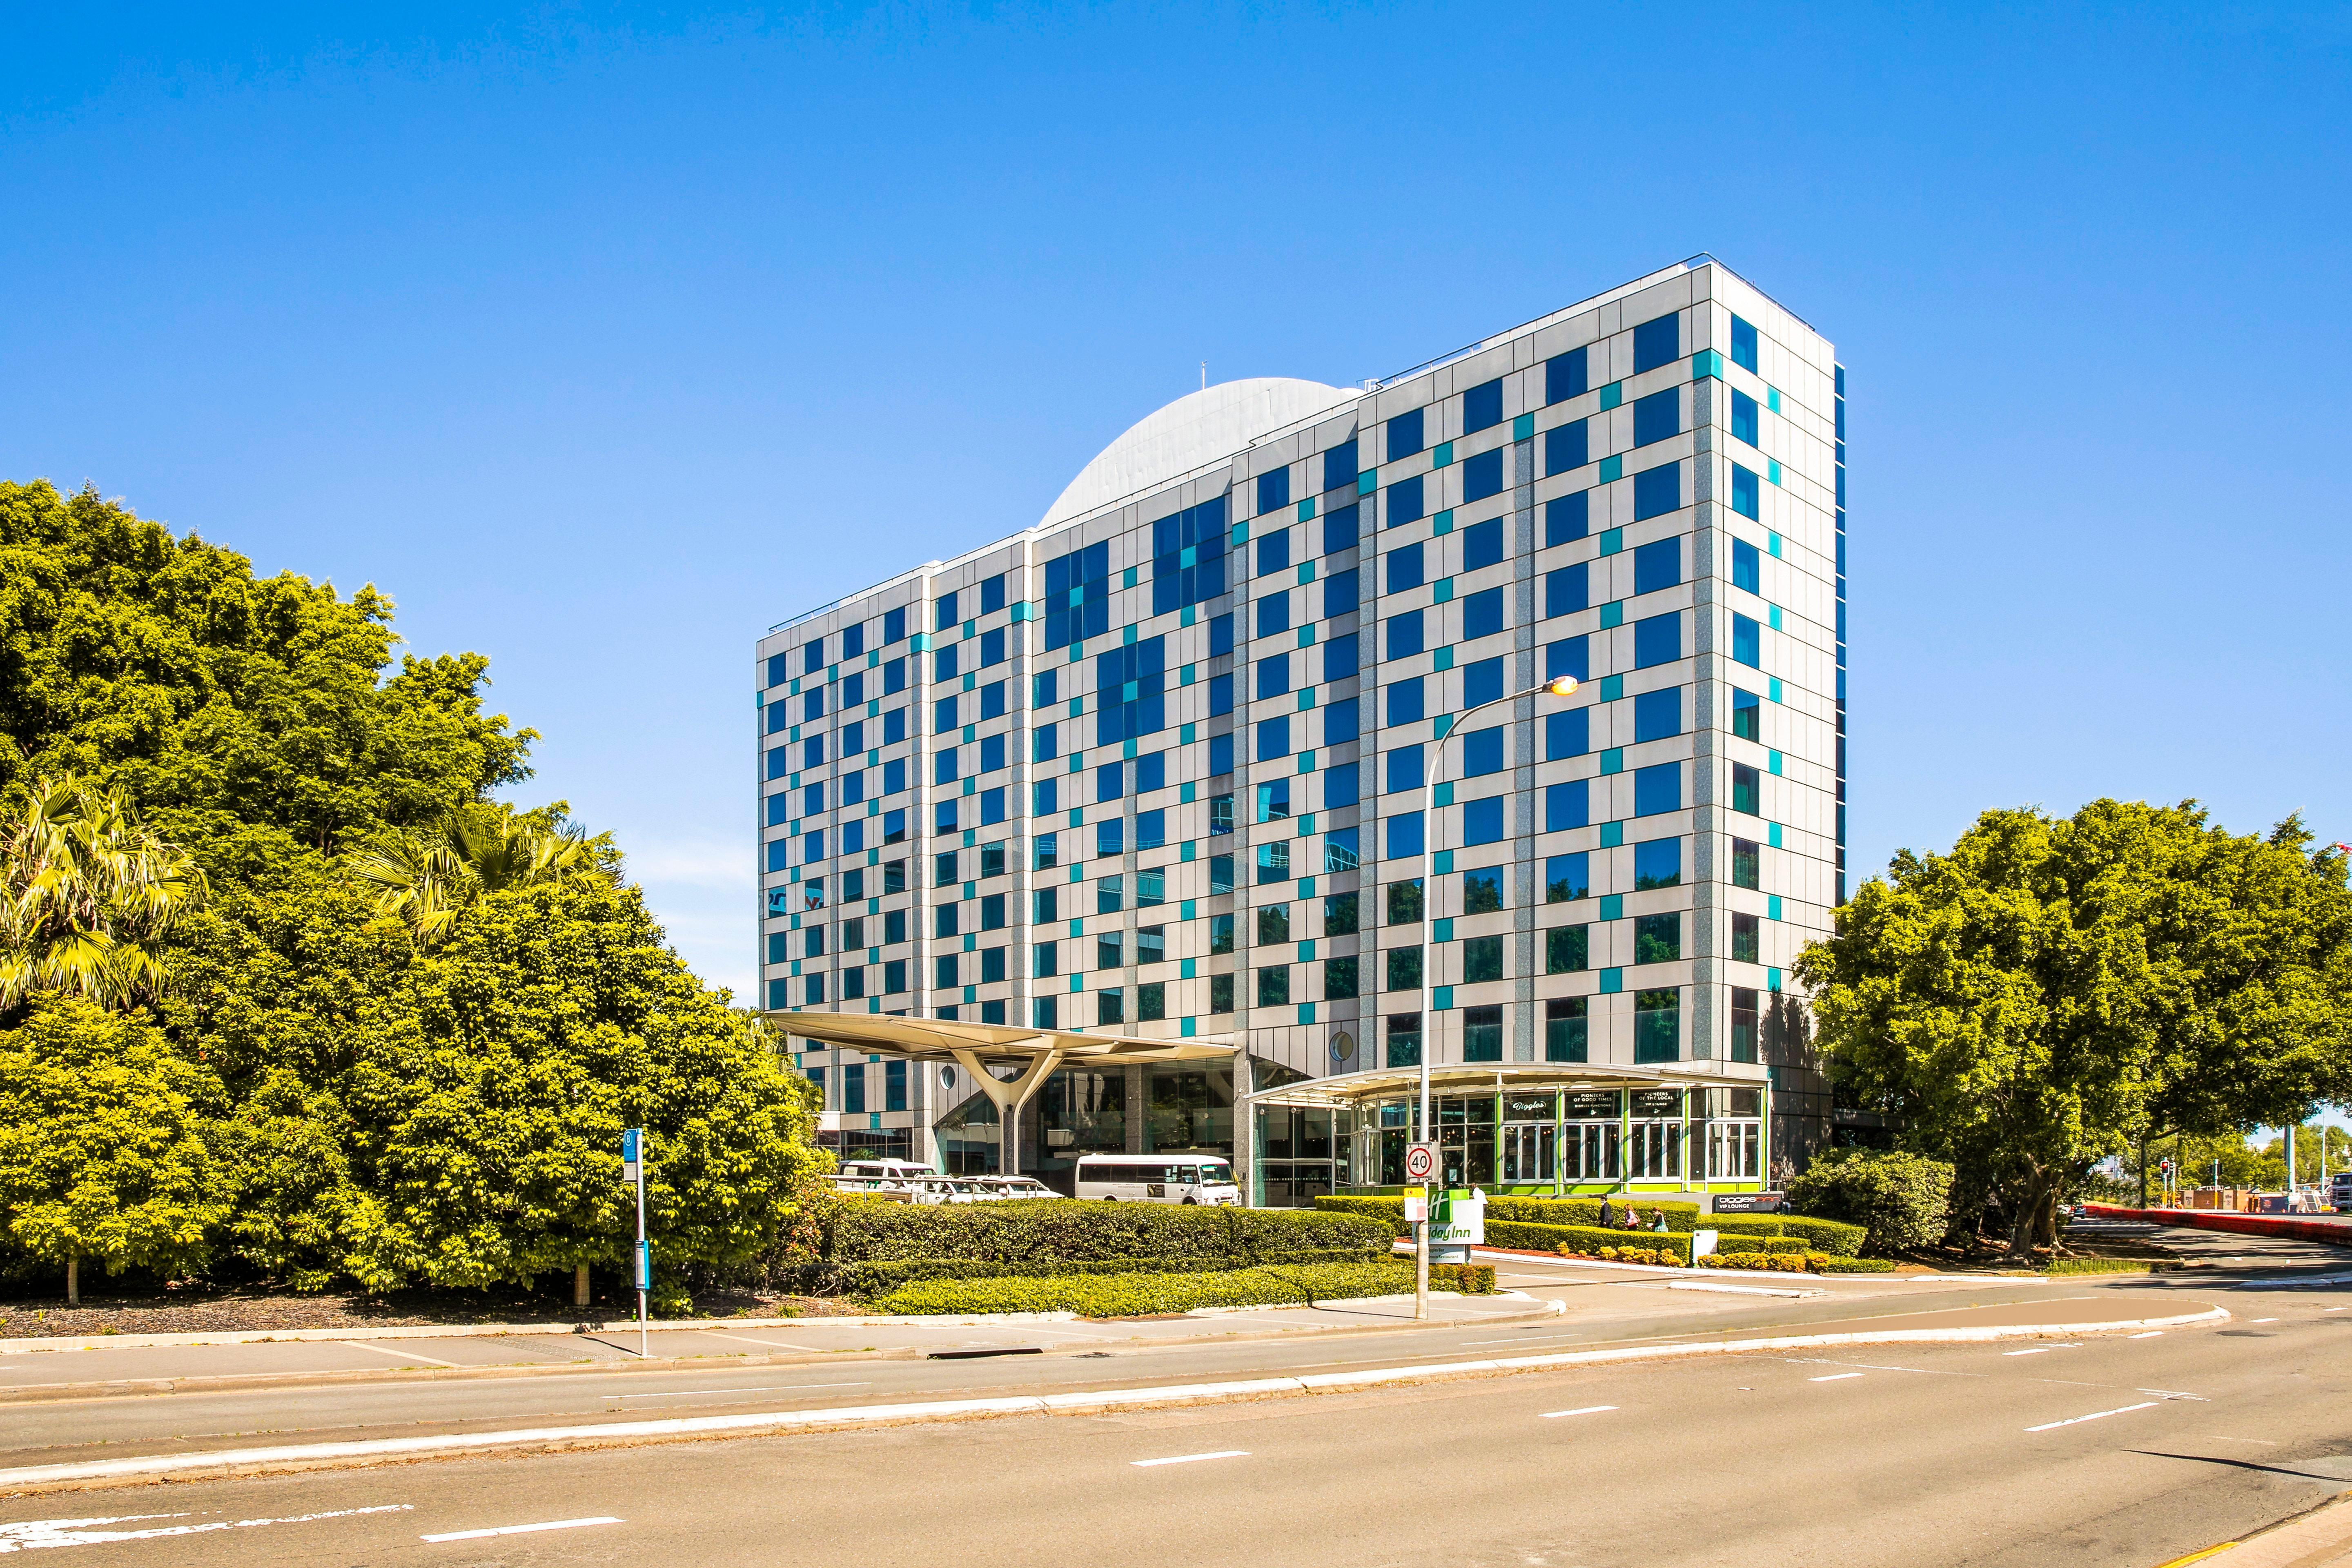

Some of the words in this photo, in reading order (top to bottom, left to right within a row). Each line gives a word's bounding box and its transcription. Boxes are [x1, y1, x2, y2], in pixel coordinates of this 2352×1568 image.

[1512, 1100, 1546, 1110] Biggles
[626, 1135, 630, 1143] B
[1411, 1156, 1427, 1168] 40
[1452, 1225, 1470, 1238] Inn
